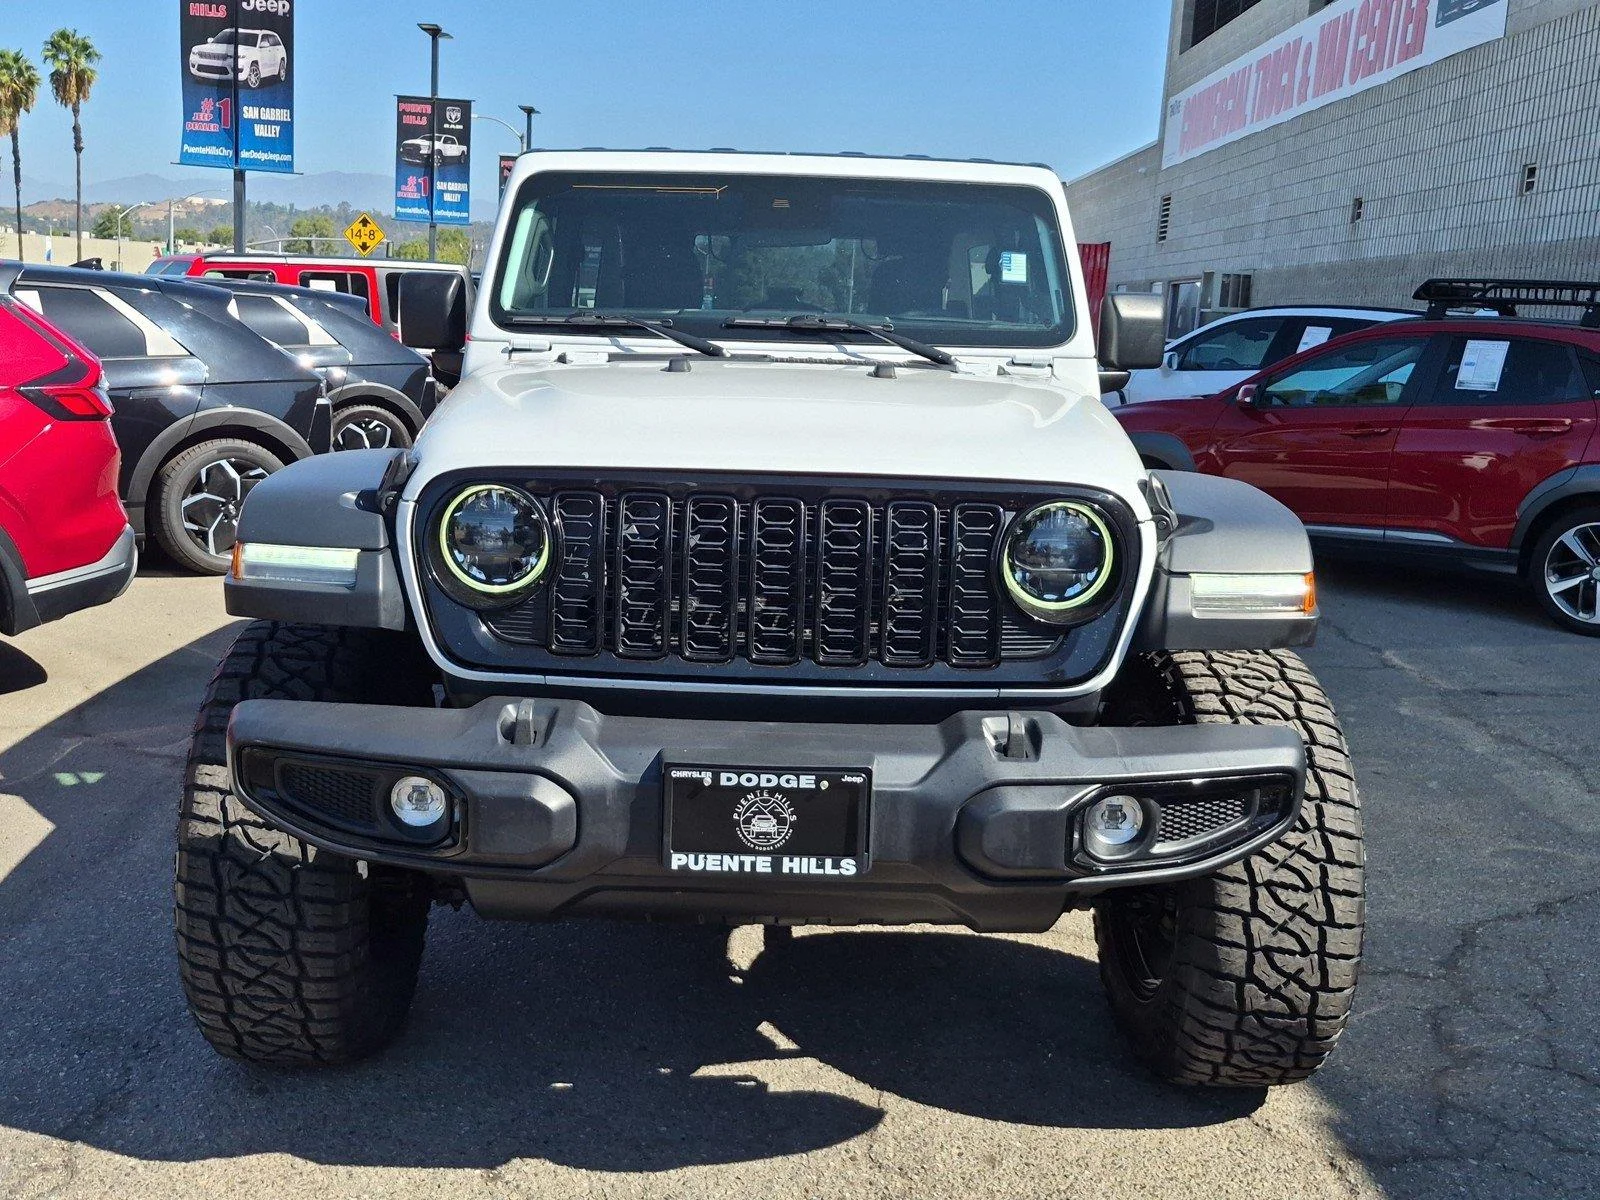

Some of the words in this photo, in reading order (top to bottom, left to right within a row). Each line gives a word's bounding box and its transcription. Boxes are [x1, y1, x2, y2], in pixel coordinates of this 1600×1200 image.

[189, 2, 227, 18] HILLS
[242, 0, 290, 16] Jeep
[1253, 36, 1303, 124] TRUCK
[1297, 41, 1313, 107] &
[1312, 8, 1354, 99] VAN
[243, 106, 259, 119] SAN
[260, 107, 292, 121] GABRIEL
[399, 102, 432, 114] PUENTE
[192, 112, 213, 121] JEEP
[402, 115, 428, 126] HILLS
[186, 122, 220, 132] DEALER
[254, 124, 280, 138] VALLEY
[436, 180, 447, 190] SAN
[443, 192, 461, 202] VALLEY
[671, 769, 713, 779] CHRYSLER
[719, 772, 816, 789] DODGE
[841, 774, 864, 784] Jeep
[732, 789, 770, 820] PUENTE
[774, 792, 797, 822] HILLS
[671, 853, 773, 873] PUENTE
[782, 857, 858, 876] HILLS
